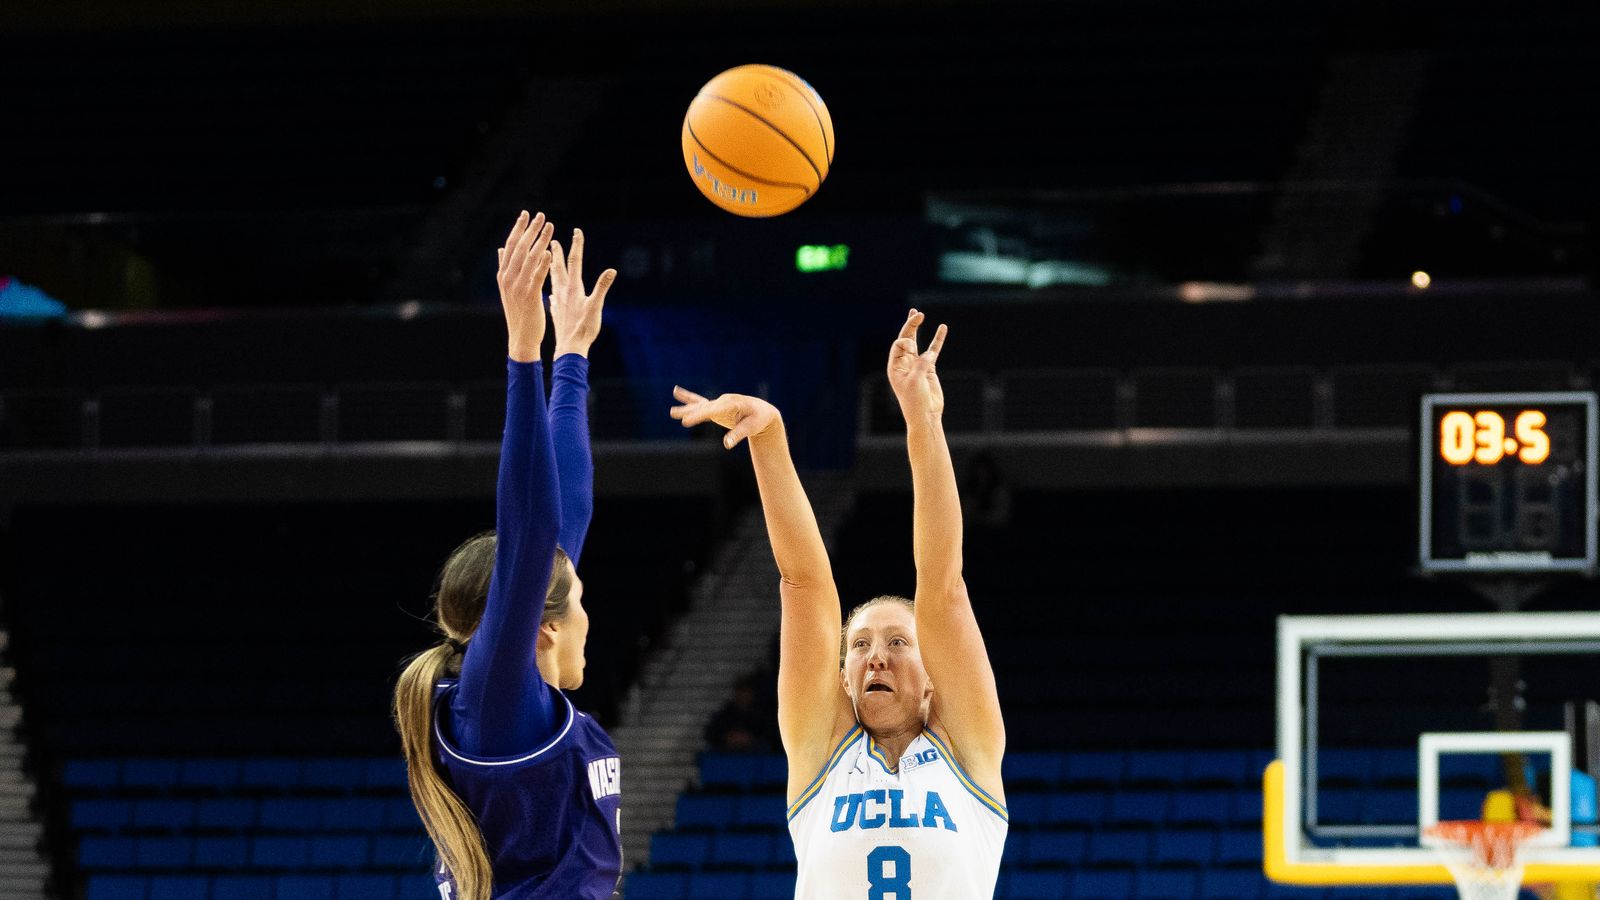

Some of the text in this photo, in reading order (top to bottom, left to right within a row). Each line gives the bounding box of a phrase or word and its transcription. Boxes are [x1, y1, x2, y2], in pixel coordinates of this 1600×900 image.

[1440, 410, 1550, 465] 03.5
[830, 789, 957, 832] UCLA
[867, 846, 911, 900] 8
